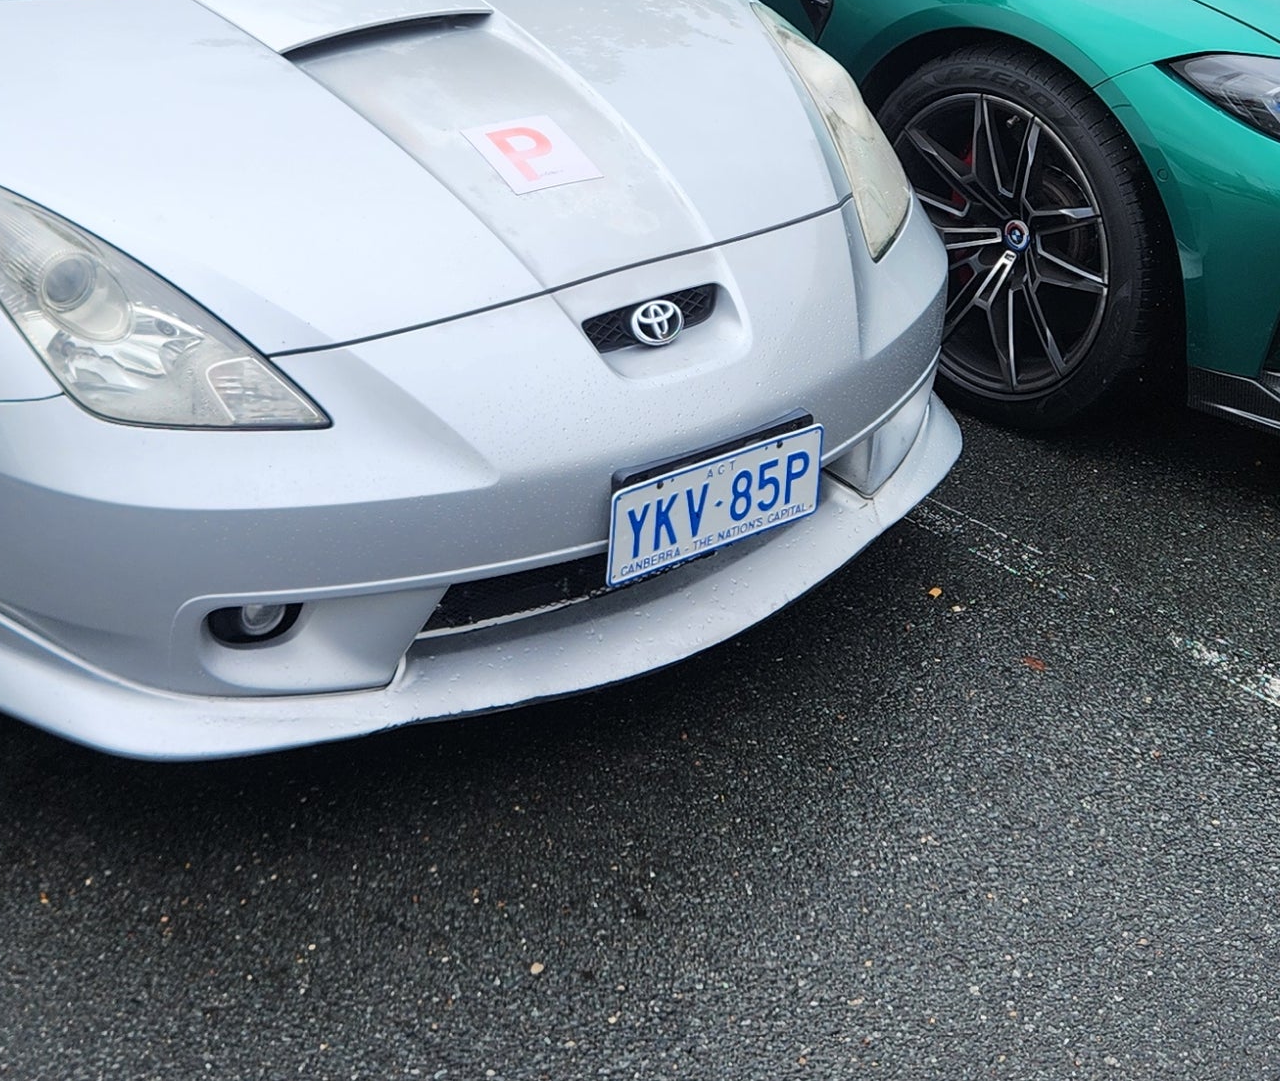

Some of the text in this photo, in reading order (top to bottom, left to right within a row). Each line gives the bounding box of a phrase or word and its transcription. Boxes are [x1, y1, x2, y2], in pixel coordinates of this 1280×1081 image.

[485, 126, 553, 182] P
[706, 459, 737, 479] ACT
[620, 546, 681, 576] CANBERRA
[692, 537, 713, 551] THE
[717, 518, 763, 541] NATION'S
[767, 503, 808, 524] CAPITAL
